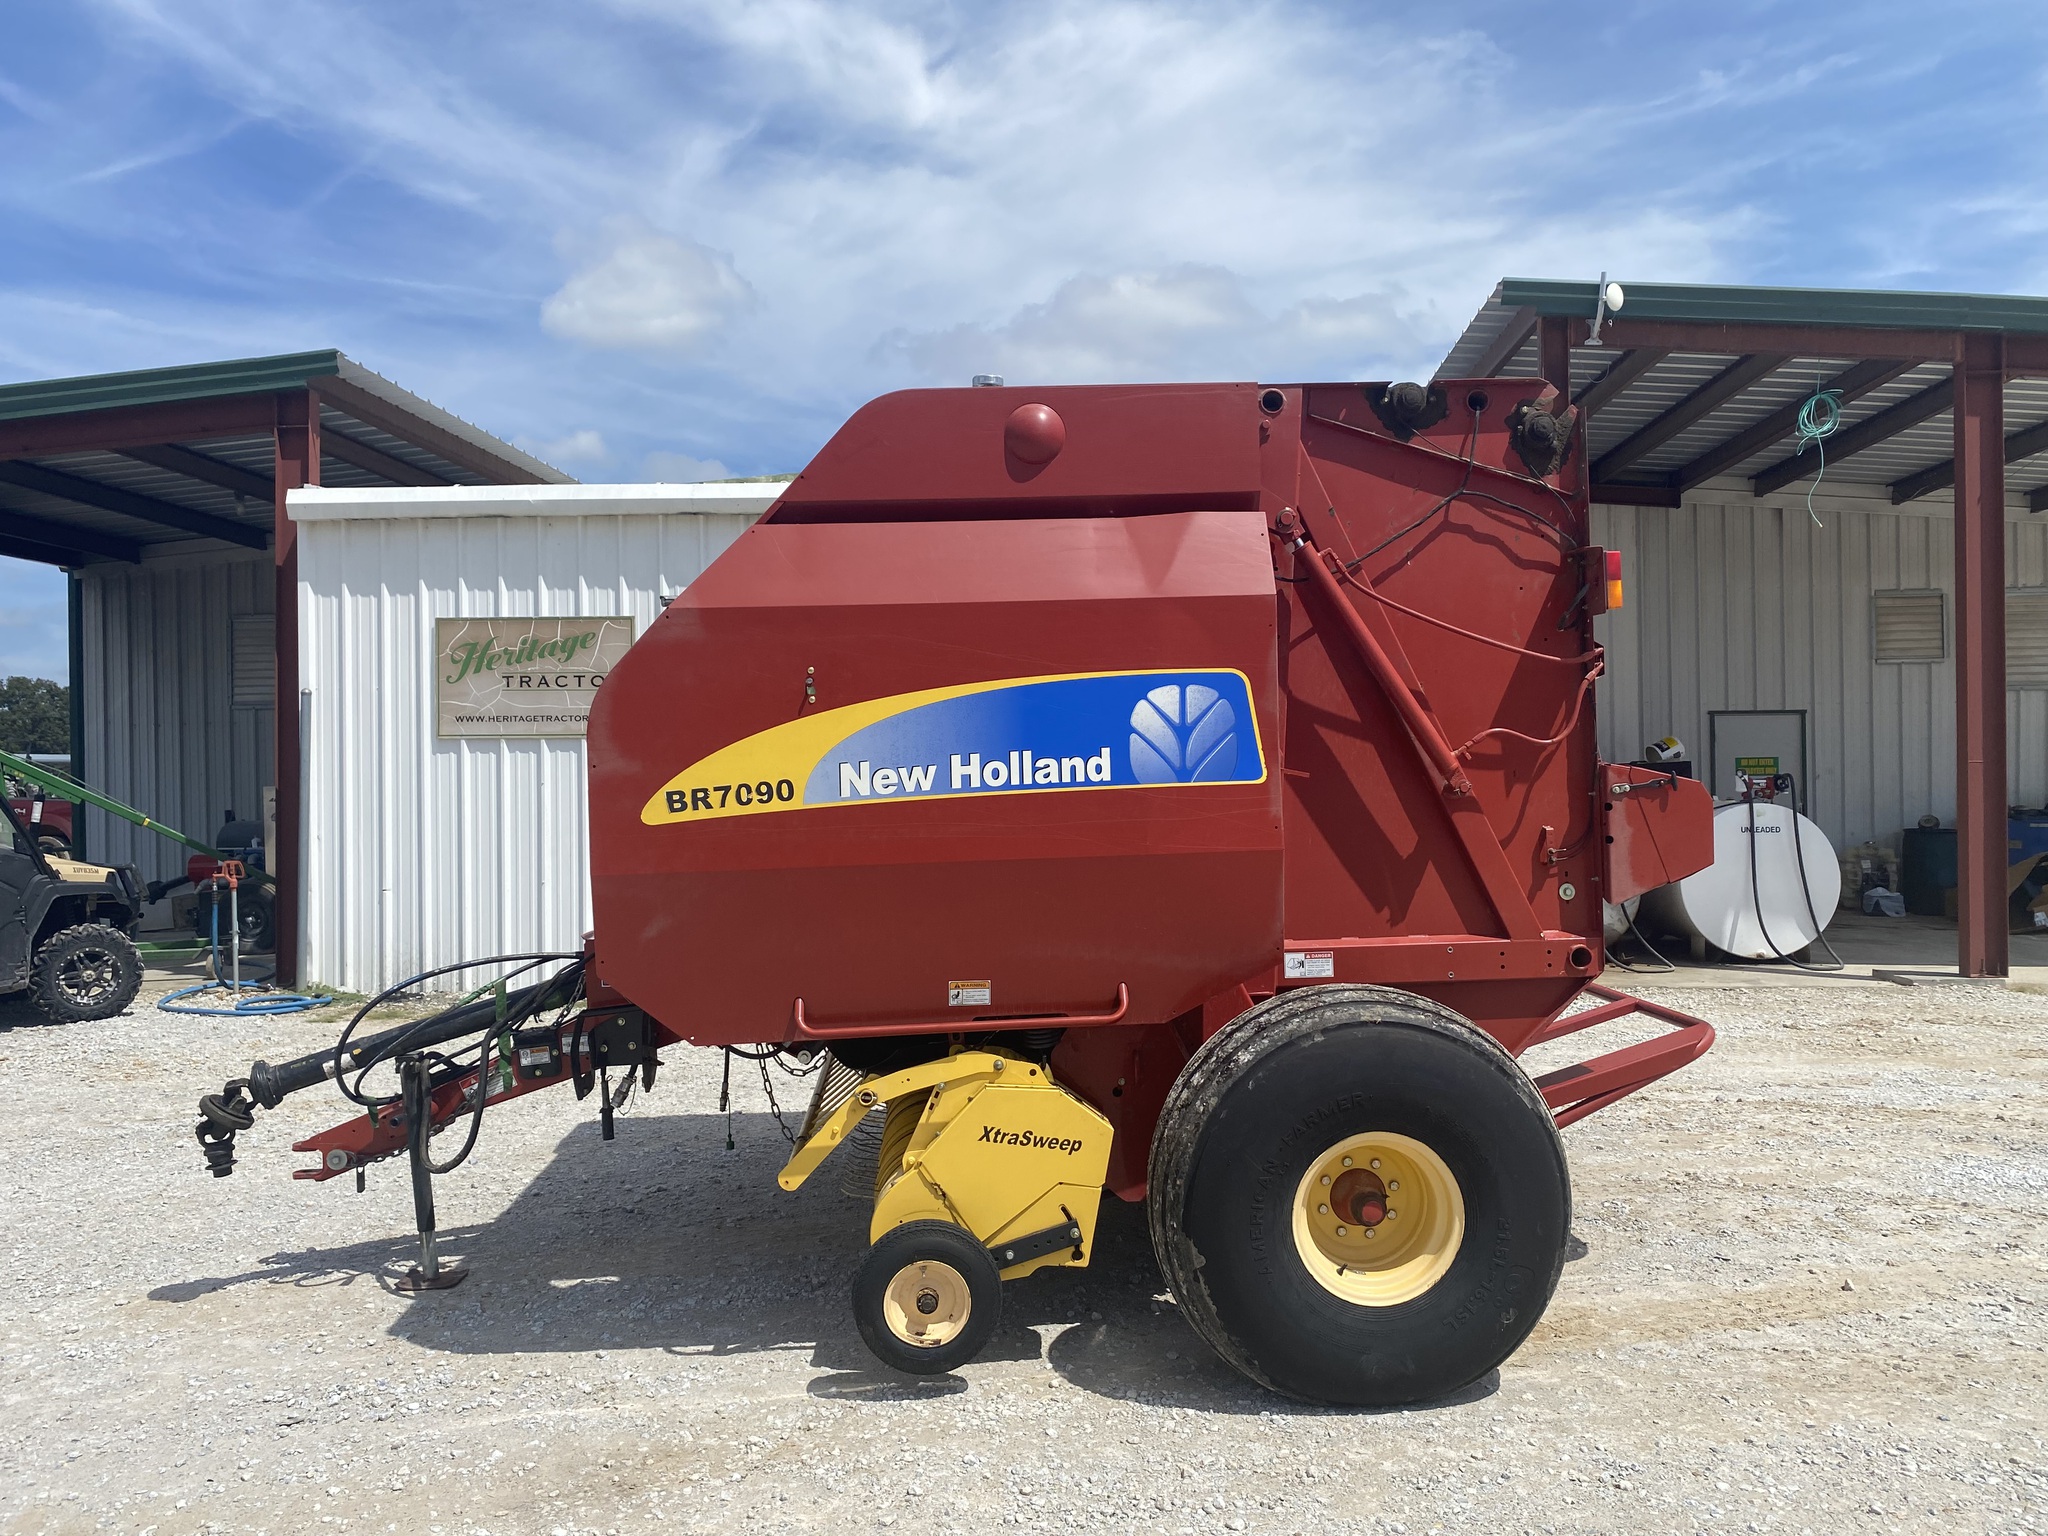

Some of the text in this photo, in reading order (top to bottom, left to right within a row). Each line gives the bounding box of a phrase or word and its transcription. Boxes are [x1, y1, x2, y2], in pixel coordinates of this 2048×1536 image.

[446, 631, 596, 684] Heritage
[502, 675, 604, 688] TRACTO
[455, 714, 589, 723] WWW.HERITAGETRACTOR
[839, 747, 1111, 798] New Holland
[665, 779, 794, 814] BR7090
[977, 1125, 1082, 1155] XtraSweep
